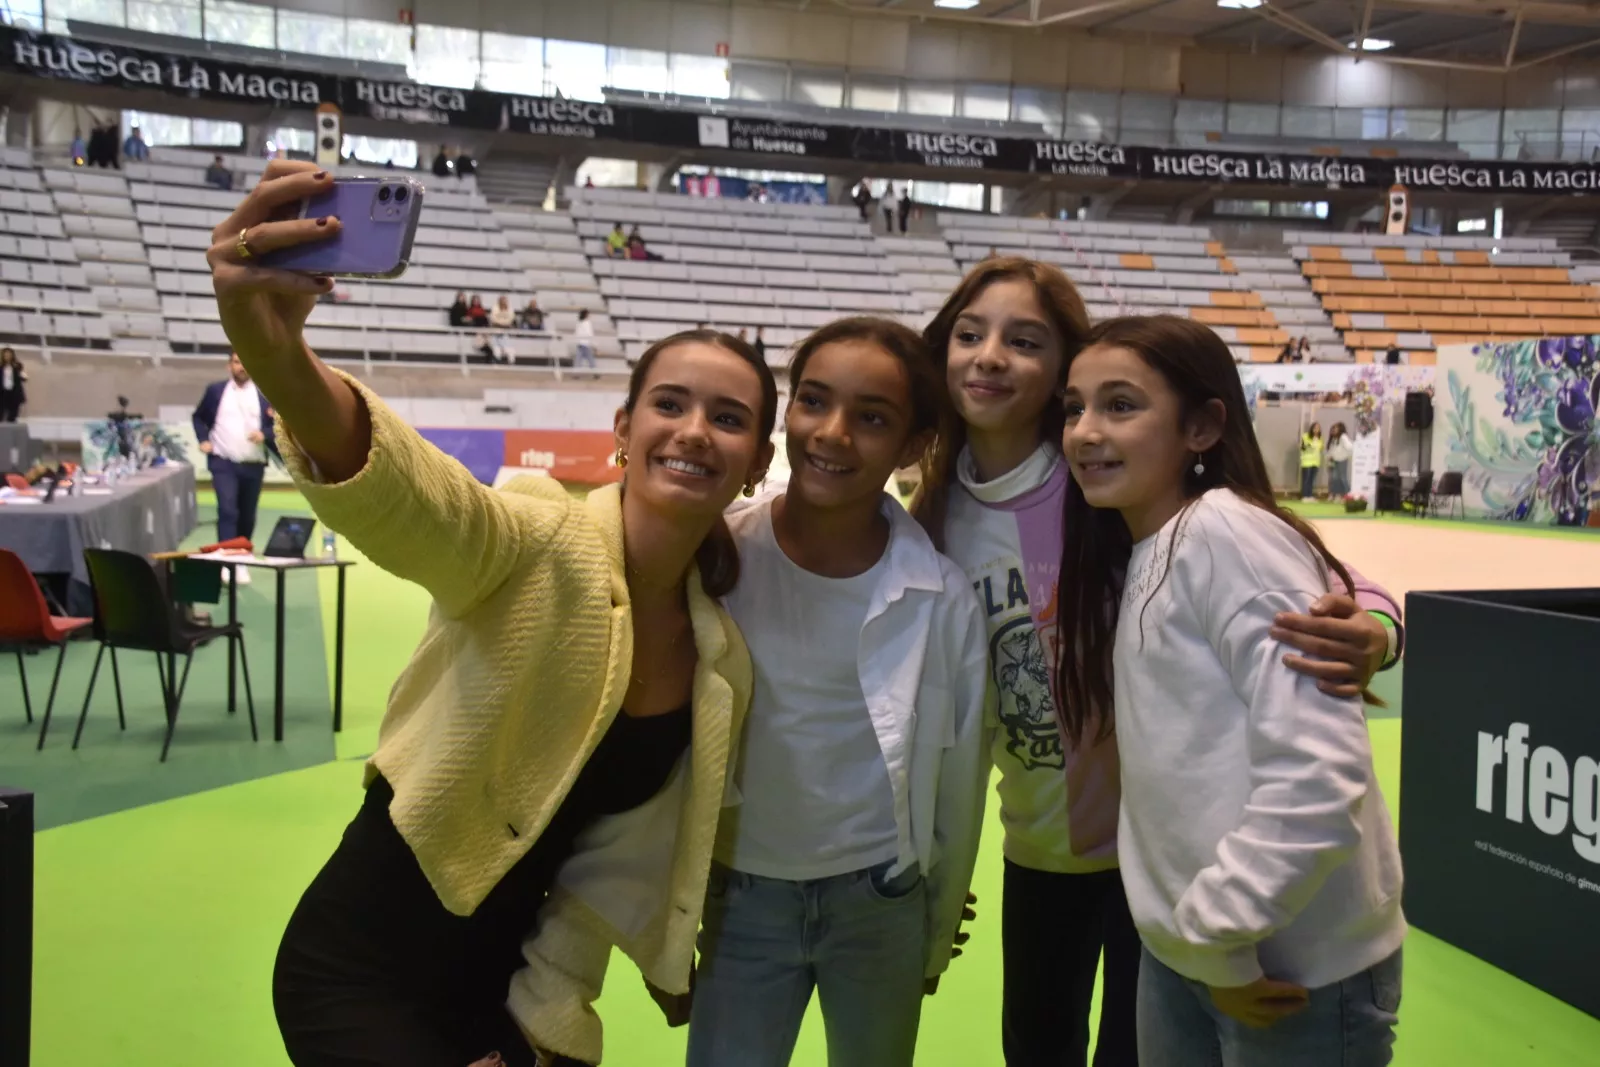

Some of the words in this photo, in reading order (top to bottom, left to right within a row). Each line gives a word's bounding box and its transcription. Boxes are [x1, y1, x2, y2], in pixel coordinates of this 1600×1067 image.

[13, 41, 162, 85] Huesca
[355, 80, 466, 112] Huesca
[511, 97, 614, 126] Huesca
[752, 136, 806, 155] Huesca
[906, 132, 998, 157] Huesca
[1036, 140, 1126, 165] Huesca
[1152, 153, 1250, 178] Huesca
[1394, 164, 1492, 188] Huesca
[1476, 721, 1600, 864] rfeg
